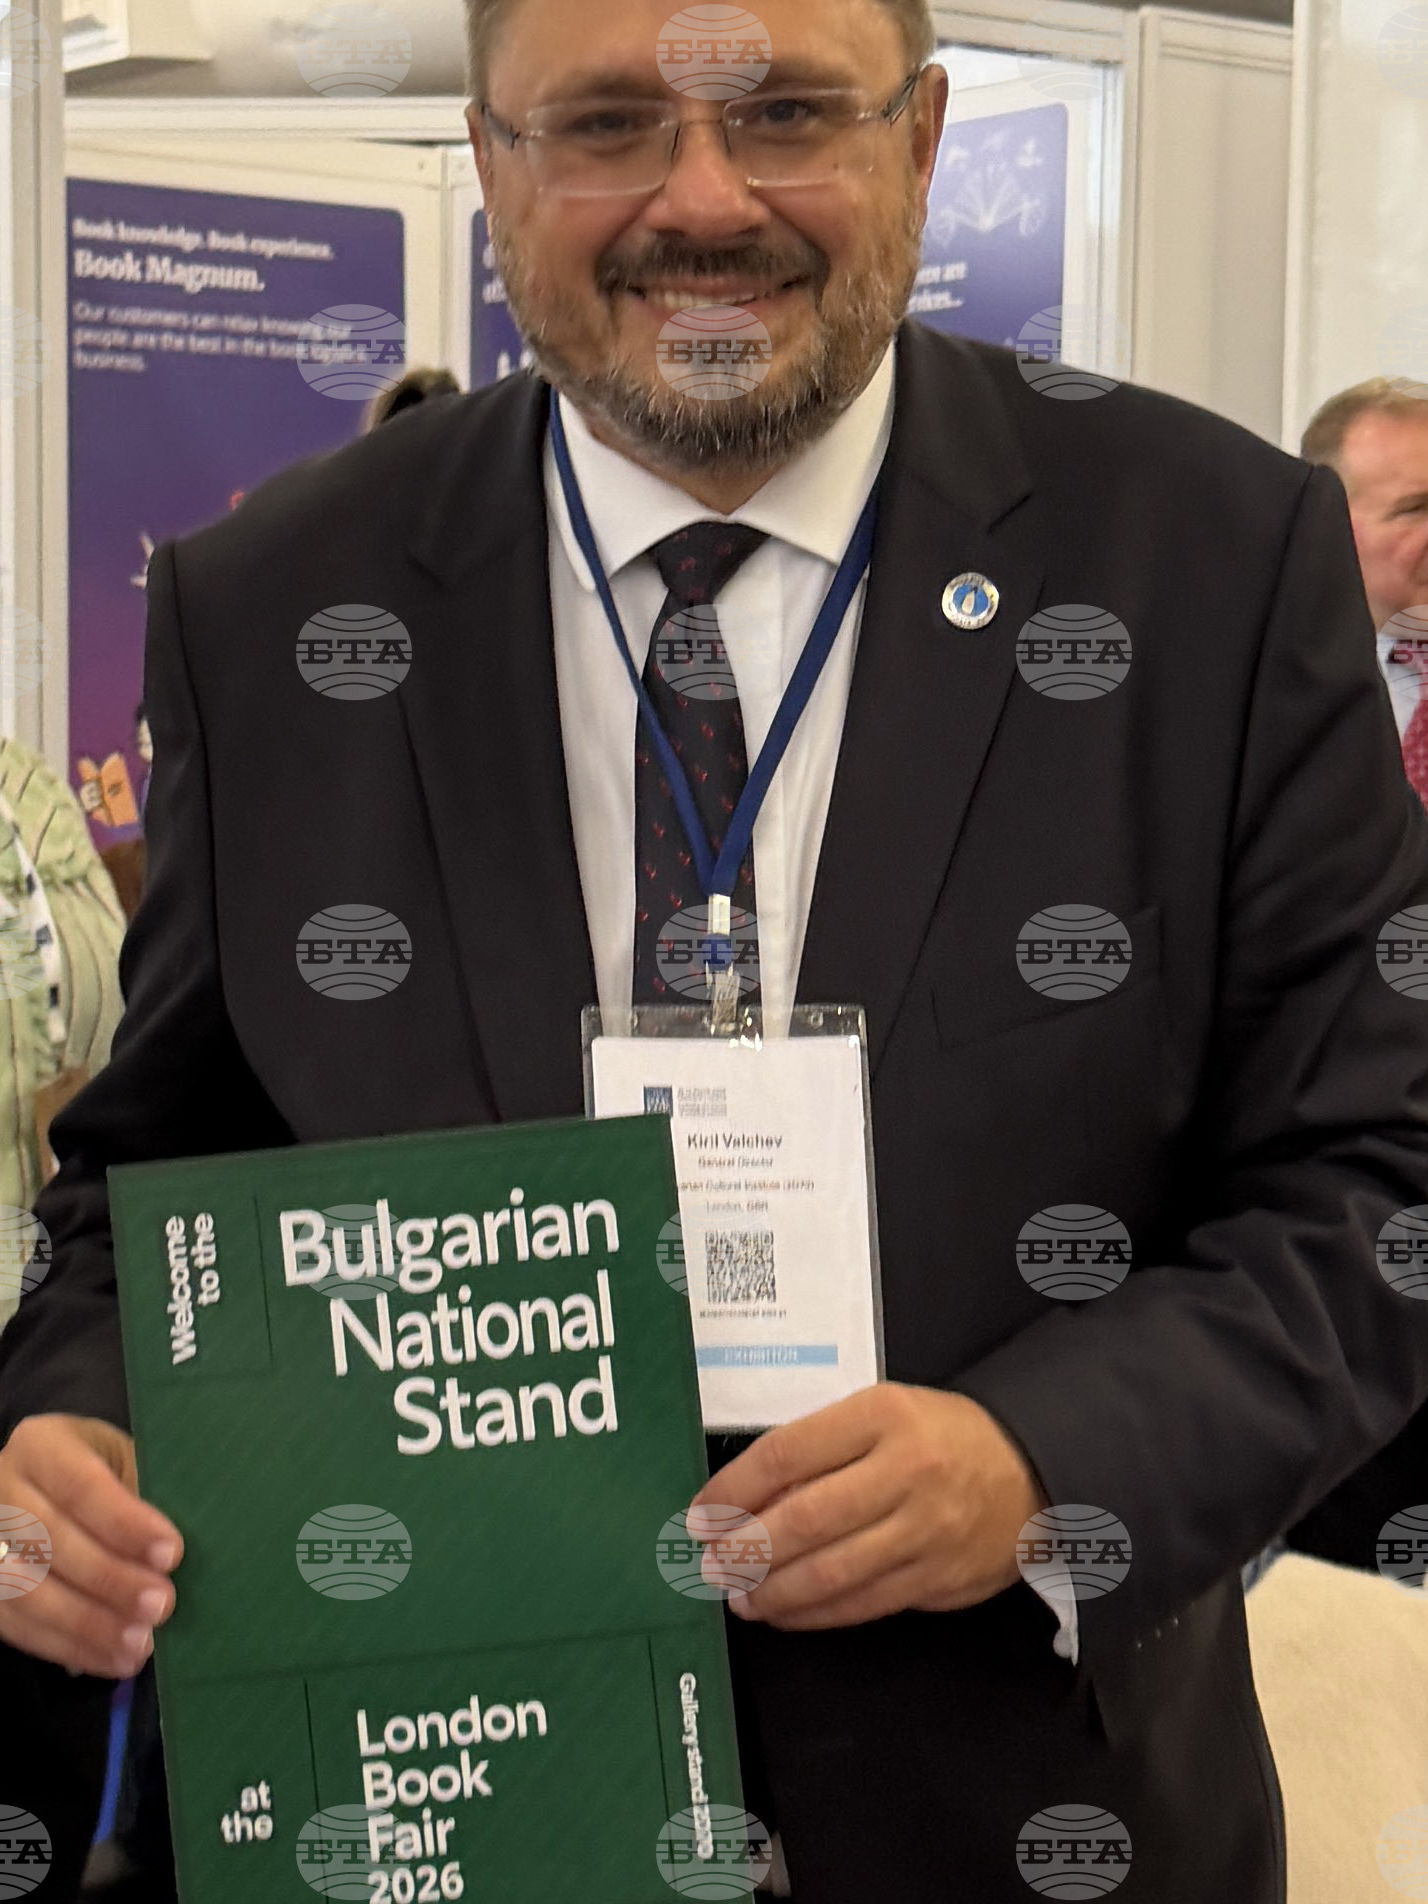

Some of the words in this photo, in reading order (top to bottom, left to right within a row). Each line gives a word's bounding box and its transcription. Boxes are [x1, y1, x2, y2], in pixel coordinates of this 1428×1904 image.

[74, 248, 142, 283] Book
[145, 252, 266, 294] Magnum.
[687, 1132, 720, 1150] Kiril
[722, 1132, 783, 1150] Valchev
[190, 1211, 218, 1268] the
[279, 1187, 621, 1295] Bulgarian
[165, 1215, 198, 1366] Welcome
[197, 1268, 221, 1307] to
[329, 1268, 616, 1377] National
[393, 1354, 619, 1456] Stand
[357, 1694, 547, 1757] London
[240, 1779, 272, 1813] at
[362, 1748, 493, 1811] Book
[220, 1810, 274, 1845] the
[367, 1806, 456, 1864] Fair
